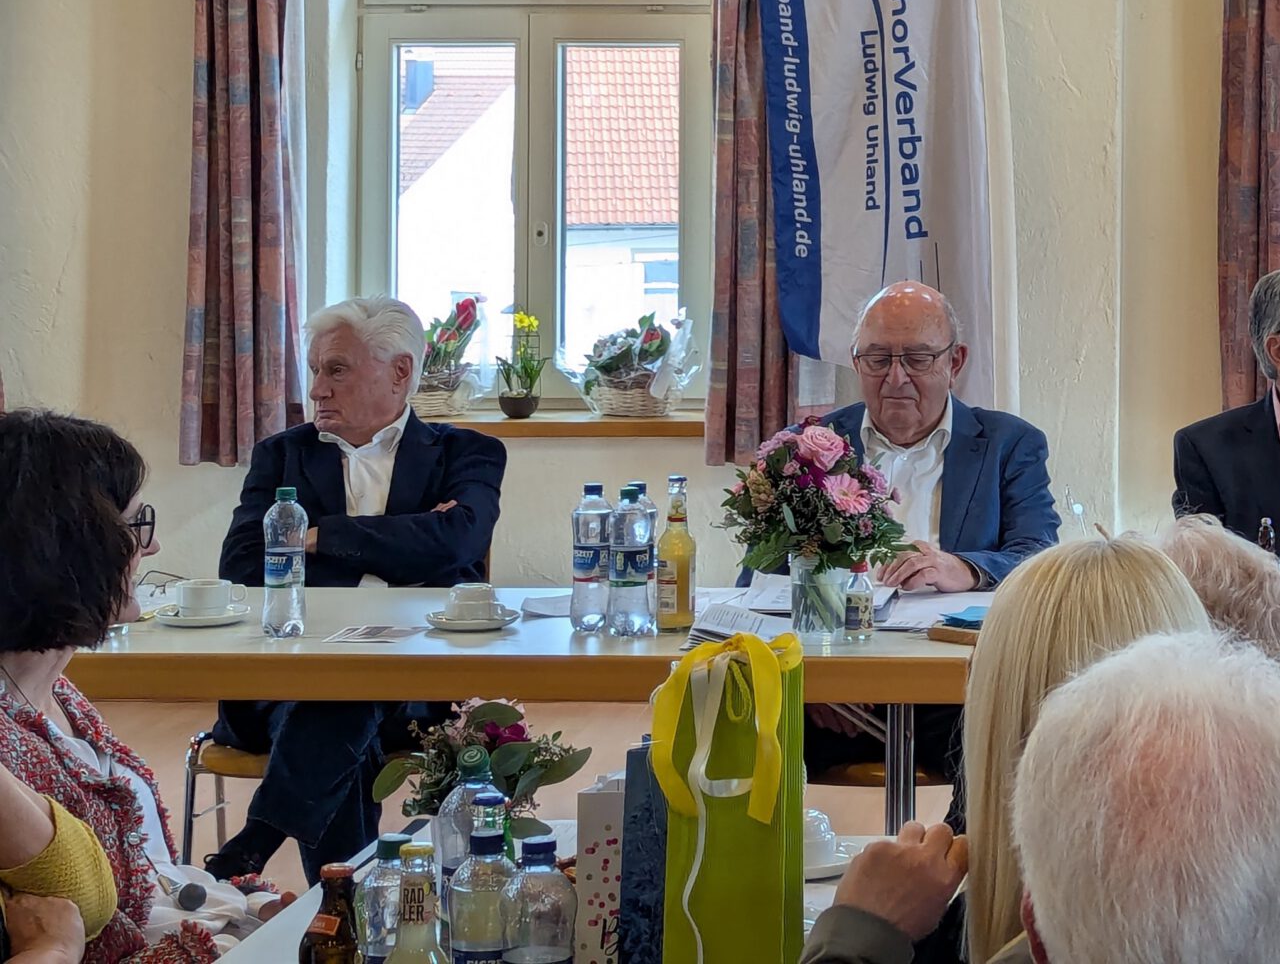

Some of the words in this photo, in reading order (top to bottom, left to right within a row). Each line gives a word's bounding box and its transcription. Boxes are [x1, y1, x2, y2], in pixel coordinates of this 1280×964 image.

[860, 29, 879, 116] Ludwig
[864, 124, 881, 211] Uhland
[402, 887, 425, 905] RAD
[402, 904, 425, 922] LER
